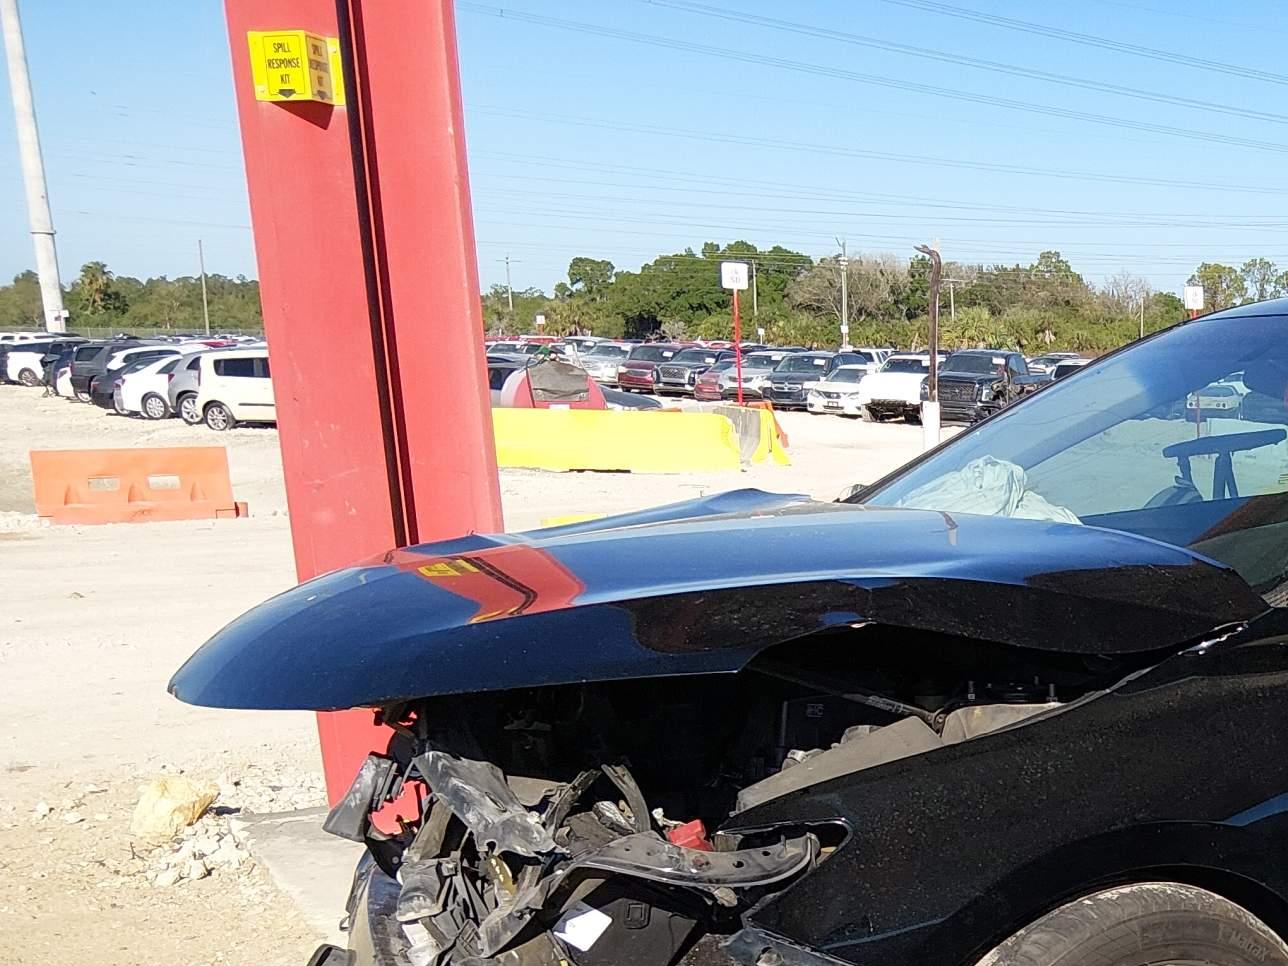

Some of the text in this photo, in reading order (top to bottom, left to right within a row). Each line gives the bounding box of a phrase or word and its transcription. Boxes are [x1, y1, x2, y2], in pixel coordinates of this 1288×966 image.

[272, 42, 292, 53] SPILL
[267, 57, 301, 69] RESPONSE
[280, 73, 291, 84] KIT
